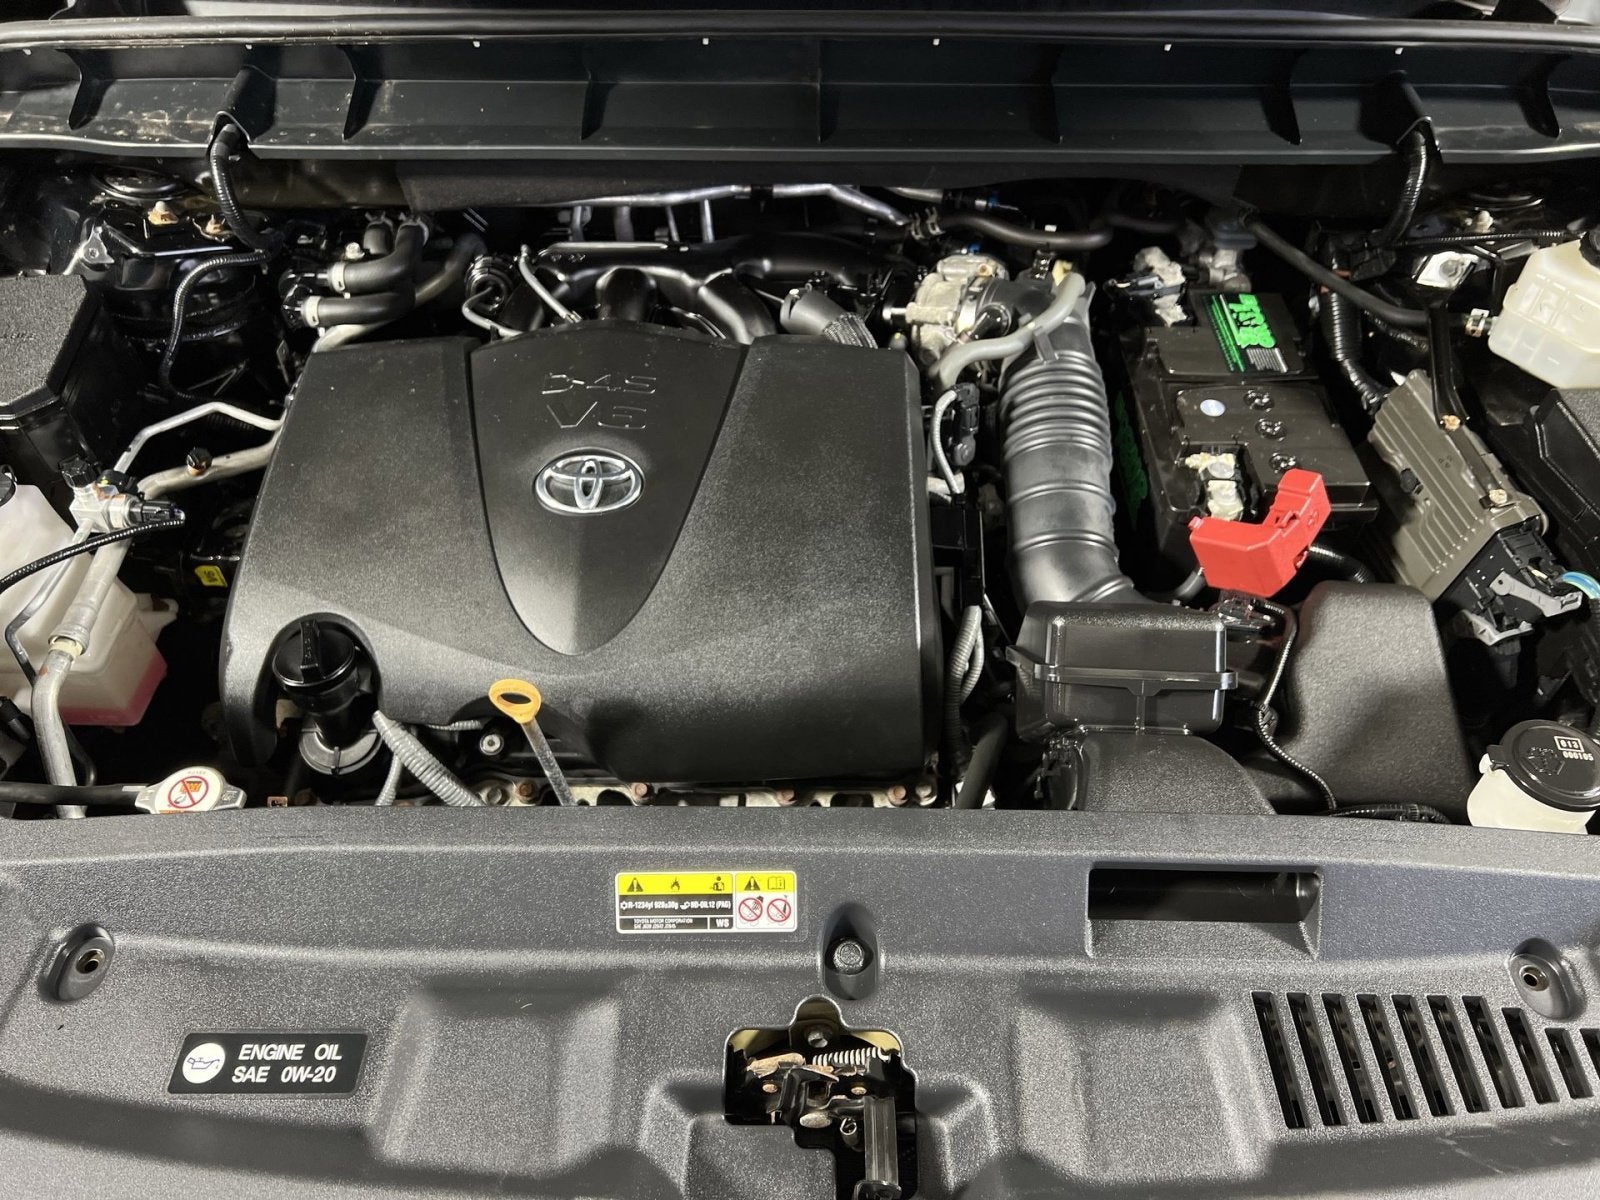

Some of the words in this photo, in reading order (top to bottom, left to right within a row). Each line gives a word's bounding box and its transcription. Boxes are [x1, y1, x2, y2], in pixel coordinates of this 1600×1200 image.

[545, 401, 647, 430] V6
[238, 1044, 305, 1061] ENGINE
[314, 1044, 343, 1061] OIL
[231, 1066, 271, 1083] SAE
[280, 1066, 337, 1083] 0W-20
